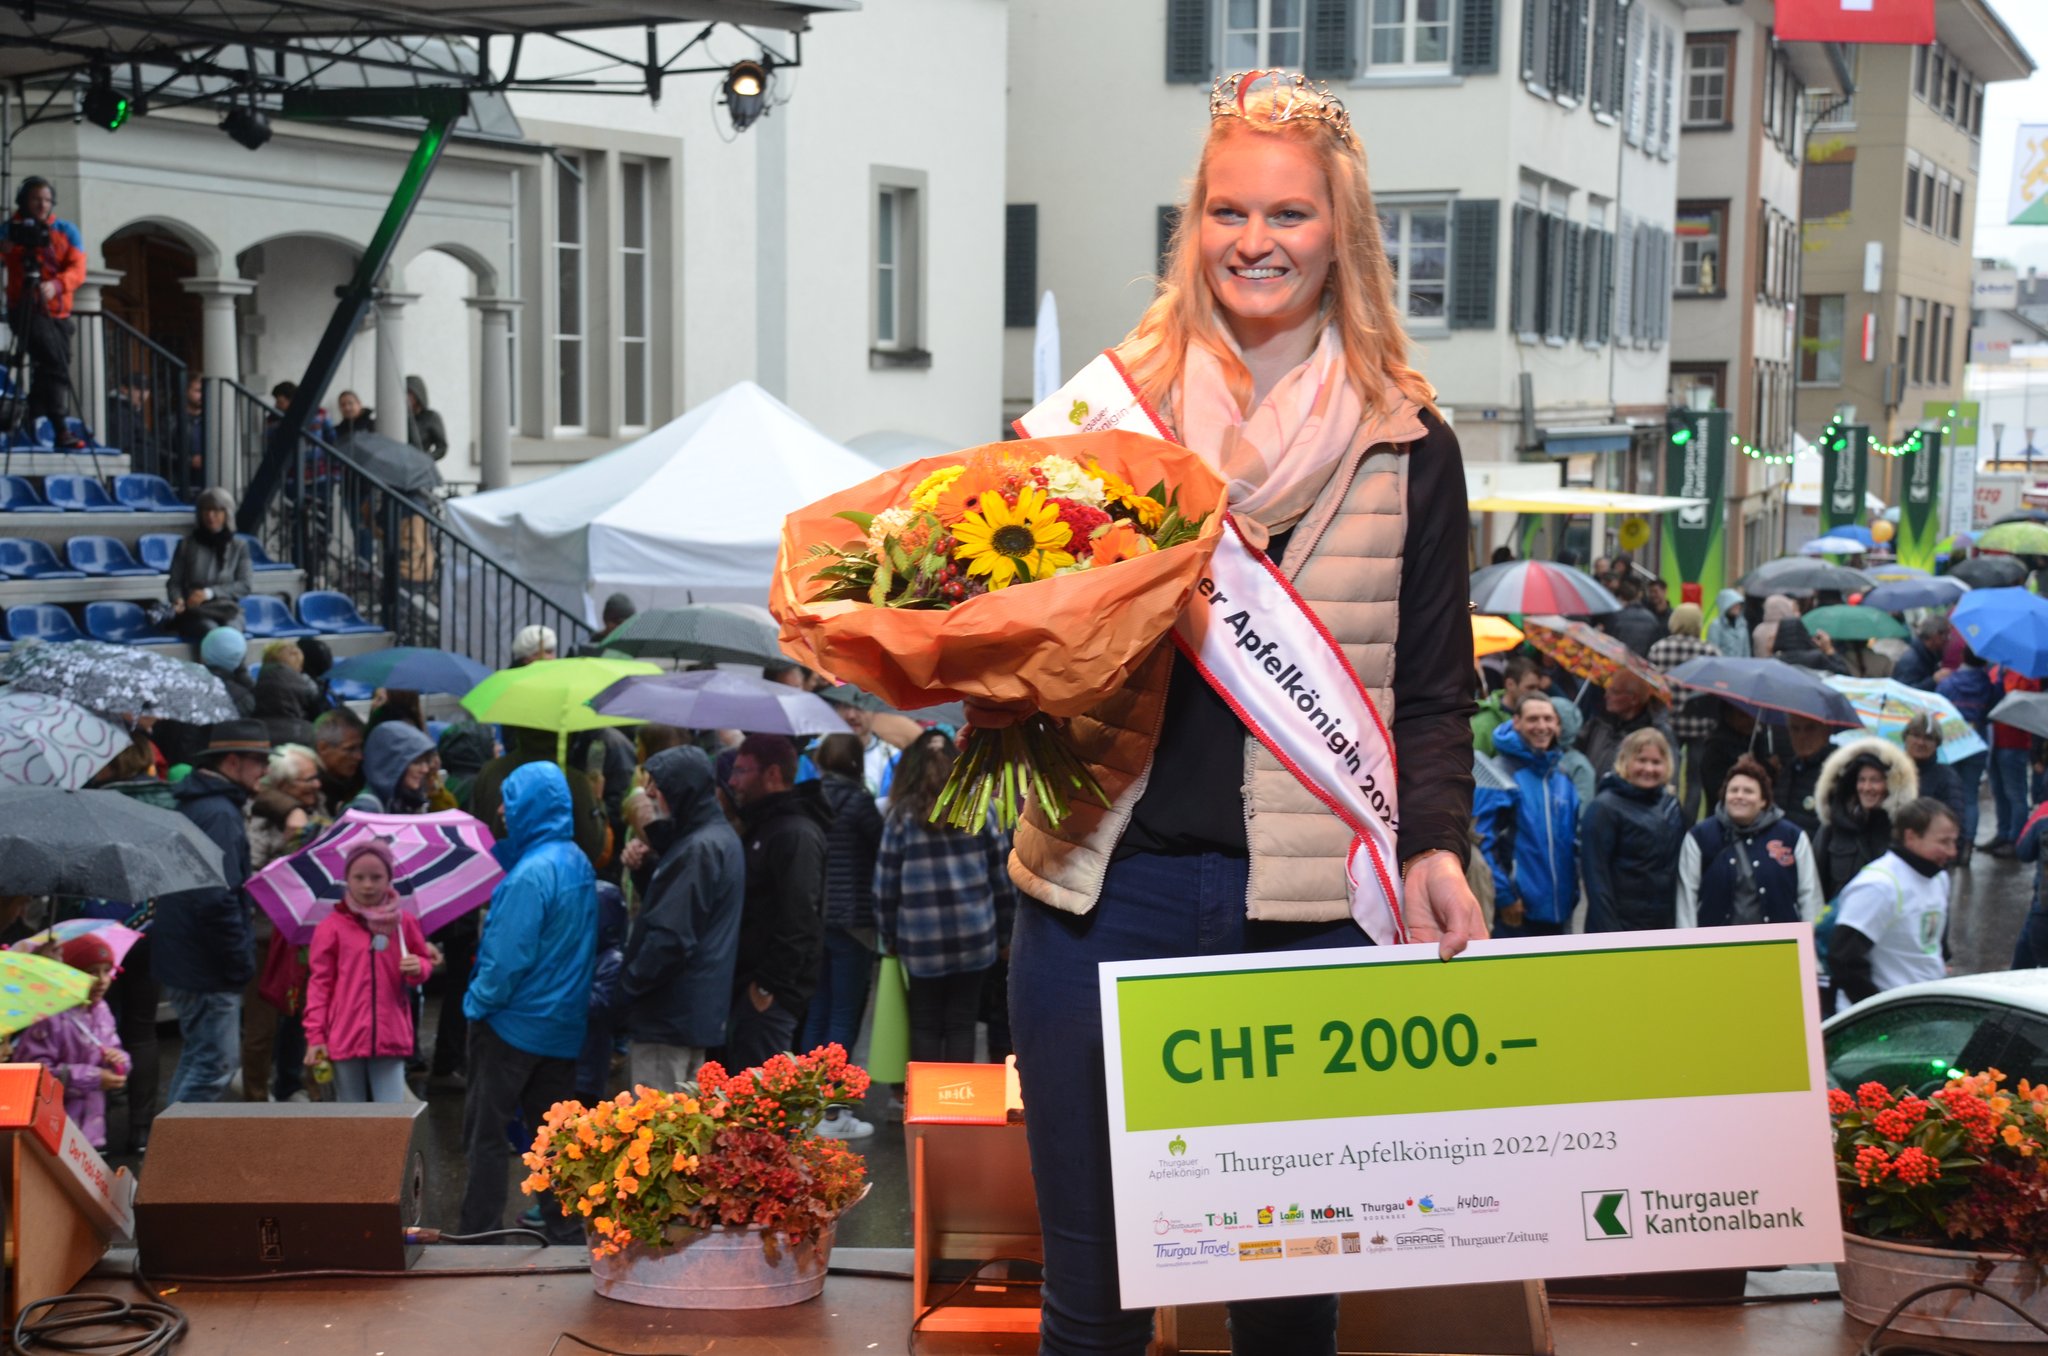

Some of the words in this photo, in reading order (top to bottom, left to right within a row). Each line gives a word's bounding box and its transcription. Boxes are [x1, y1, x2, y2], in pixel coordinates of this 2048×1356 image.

[1223, 610, 1361, 776] Apfelkönigin
[1162, 1023, 1295, 1084] CHF
[1215, 1150, 1335, 1177] Thurgauer
[1338, 1136, 1487, 1171] Apfelkönigin
[1492, 1130, 1618, 1158] 2022/2023
[1158, 1158, 1199, 1169] Thurgauer
[1148, 1165, 1210, 1181] Apfelkönigin
[1361, 1202, 1405, 1214] Thurgau
[1457, 1194, 1495, 1209] kybun
[1640, 1189, 1760, 1213] Thurgauer
[1205, 1211, 1238, 1227] Tobi
[1645, 1206, 1805, 1235] Kantonalbank
[1396, 1233, 1445, 1245] GARAGE
[1153, 1242, 1197, 1260] Thurgau
[1197, 1239, 1230, 1255] Travel
